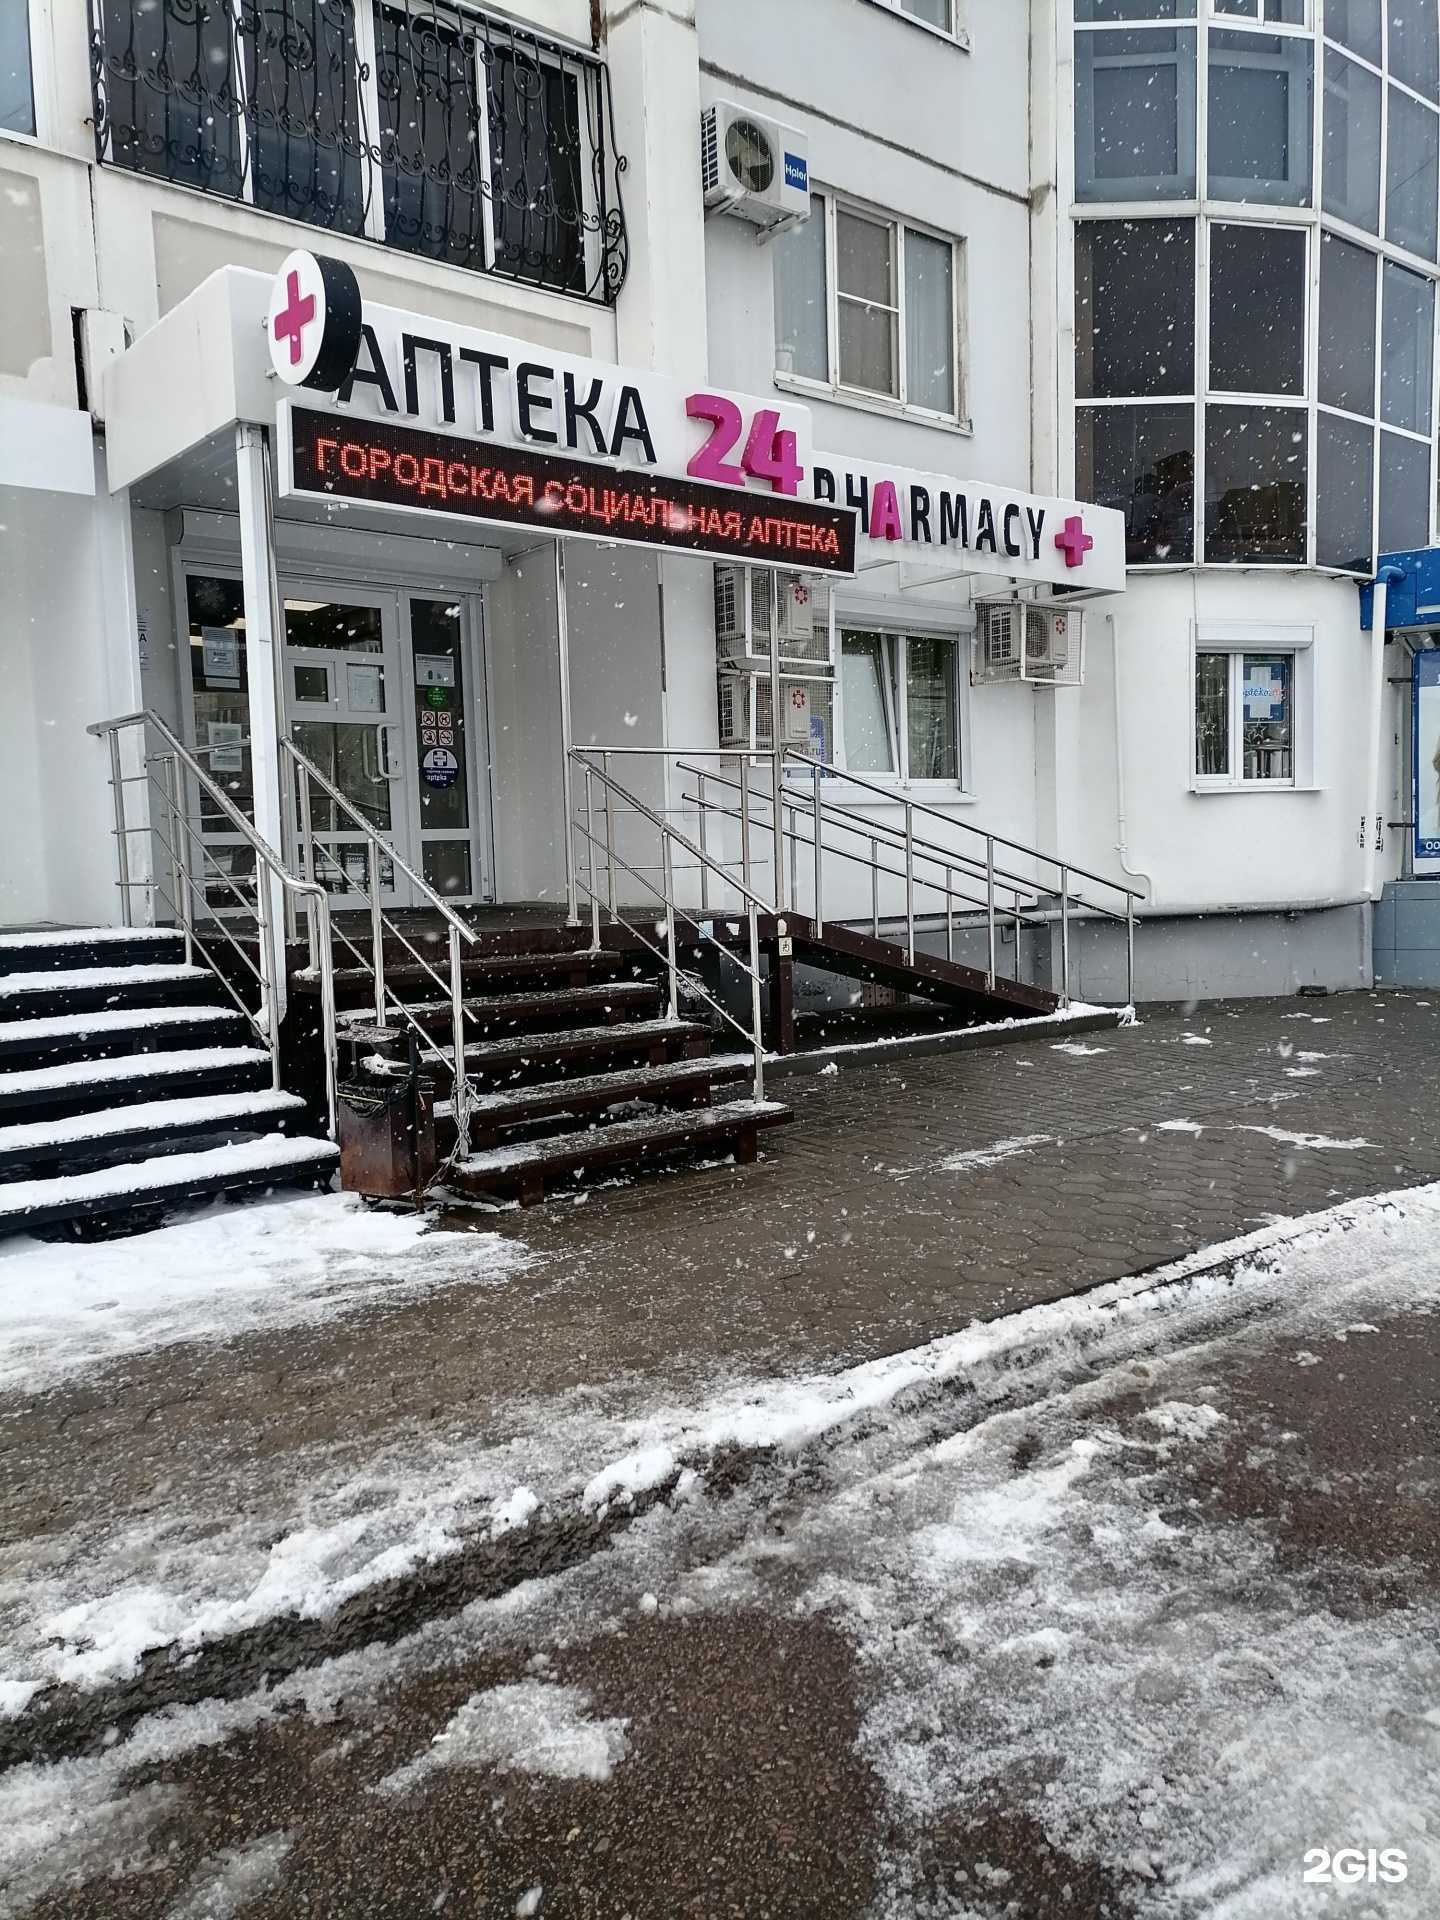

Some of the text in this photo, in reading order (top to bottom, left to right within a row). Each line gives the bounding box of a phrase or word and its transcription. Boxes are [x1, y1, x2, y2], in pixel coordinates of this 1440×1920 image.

[785, 163, 808, 182] Haier
[335, 323, 804, 496] АПТЕКА 24
[316, 438, 840, 554] ГОРОДСКАЯ СОЦИАЛЬНАЯ АПТЕКА
[812, 466, 1046, 560] PHARMACY
